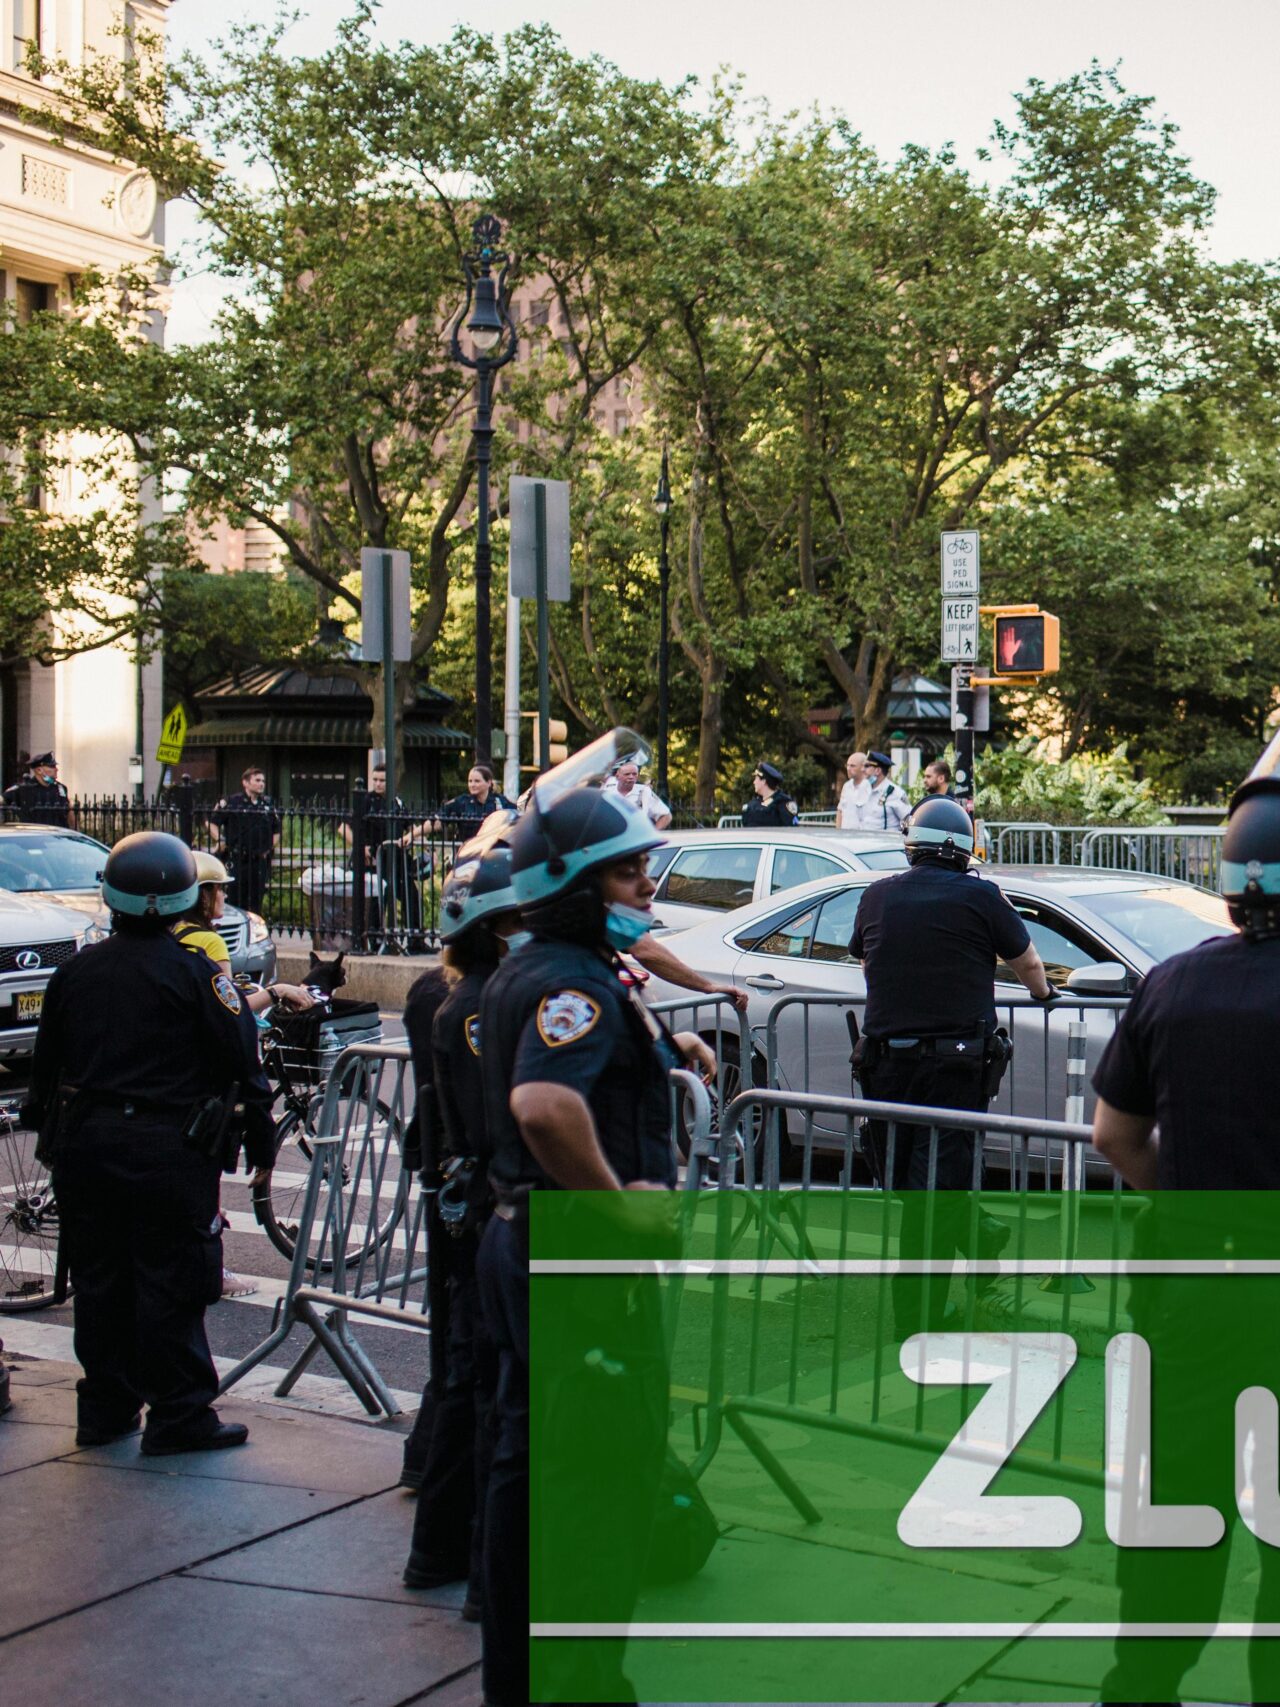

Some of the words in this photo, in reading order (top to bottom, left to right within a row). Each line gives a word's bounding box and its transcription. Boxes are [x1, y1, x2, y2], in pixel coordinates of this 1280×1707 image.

[953, 558, 967, 567] USE
[953, 569, 967, 578] PED
[947, 580, 973, 589] SIGNAL
[947, 604, 973, 620] KEEP
[945, 623, 958, 633] LEFT
[960, 623, 975, 632] RIGHT
